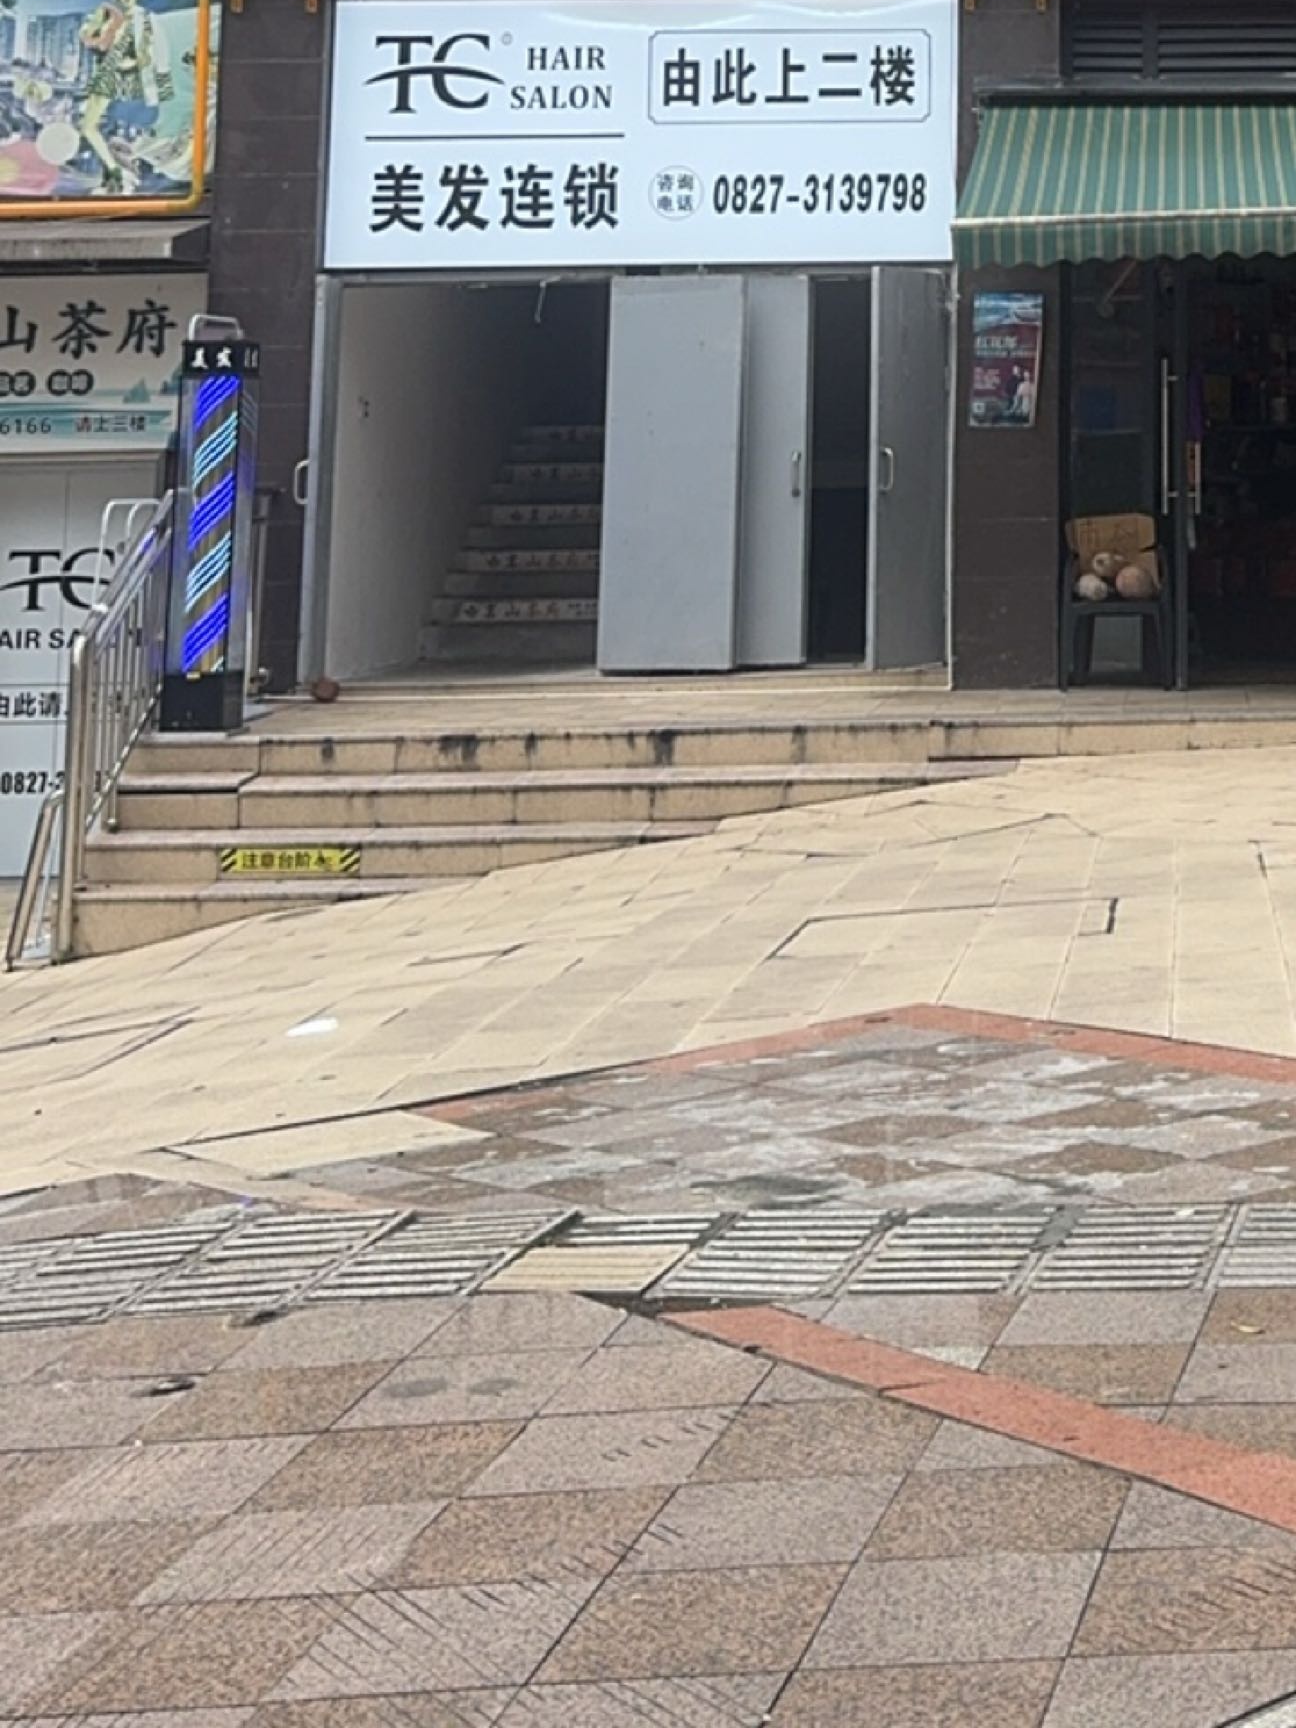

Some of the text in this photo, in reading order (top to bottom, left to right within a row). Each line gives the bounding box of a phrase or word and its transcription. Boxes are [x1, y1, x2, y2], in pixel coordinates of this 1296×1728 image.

[527, 46, 606, 71] HAIR
[662, 45, 917, 109] 由此上二楼
[510, 85, 613, 110] SALON
[369, 162, 620, 233] 美发连锁
[713, 172, 927, 214] 0827-3139798
